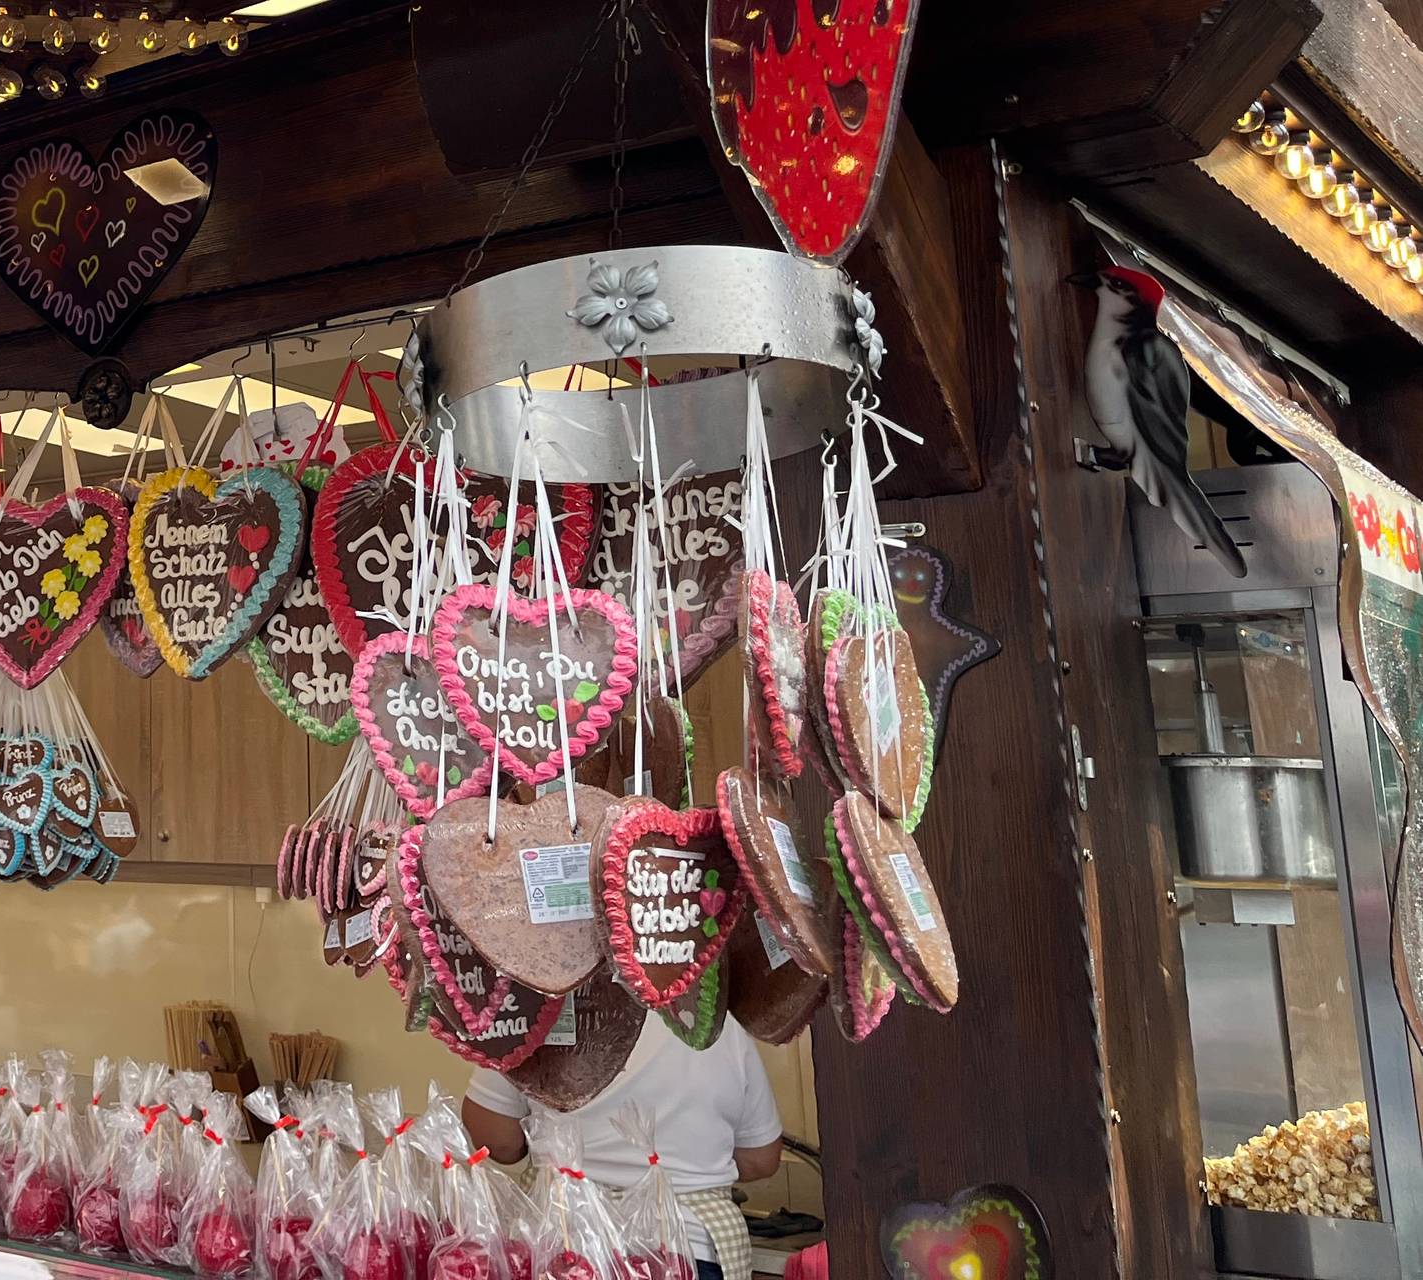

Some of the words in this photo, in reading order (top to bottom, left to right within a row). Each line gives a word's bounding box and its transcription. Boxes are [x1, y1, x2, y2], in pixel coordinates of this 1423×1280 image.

[144, 515, 230, 549] Meinem
[347, 503, 439, 582] Ich
[13, 527, 67, 576] Dich
[149, 547, 228, 578] Schatz
[110, 591, 141, 618] mic
[284, 569, 325, 608] ei
[172, 609, 228, 643] Gute
[267, 614, 346, 676] Supe
[539, 650, 596, 683] Du
[292, 672, 351, 705] Sta
[386, 682, 456, 722] Lieb
[477, 680, 534, 715] bist
[396, 716, 466, 755] Oma
[498, 714, 557, 750] toll
[2, 787, 36, 807] Prinz
[59, 781, 86, 798] Prinz
[627, 849, 668, 897] Für
[671, 859, 702, 893] die
[435, 923, 474, 956] bis
[633, 936, 696, 964] Mama
[454, 958, 486, 996] toll
